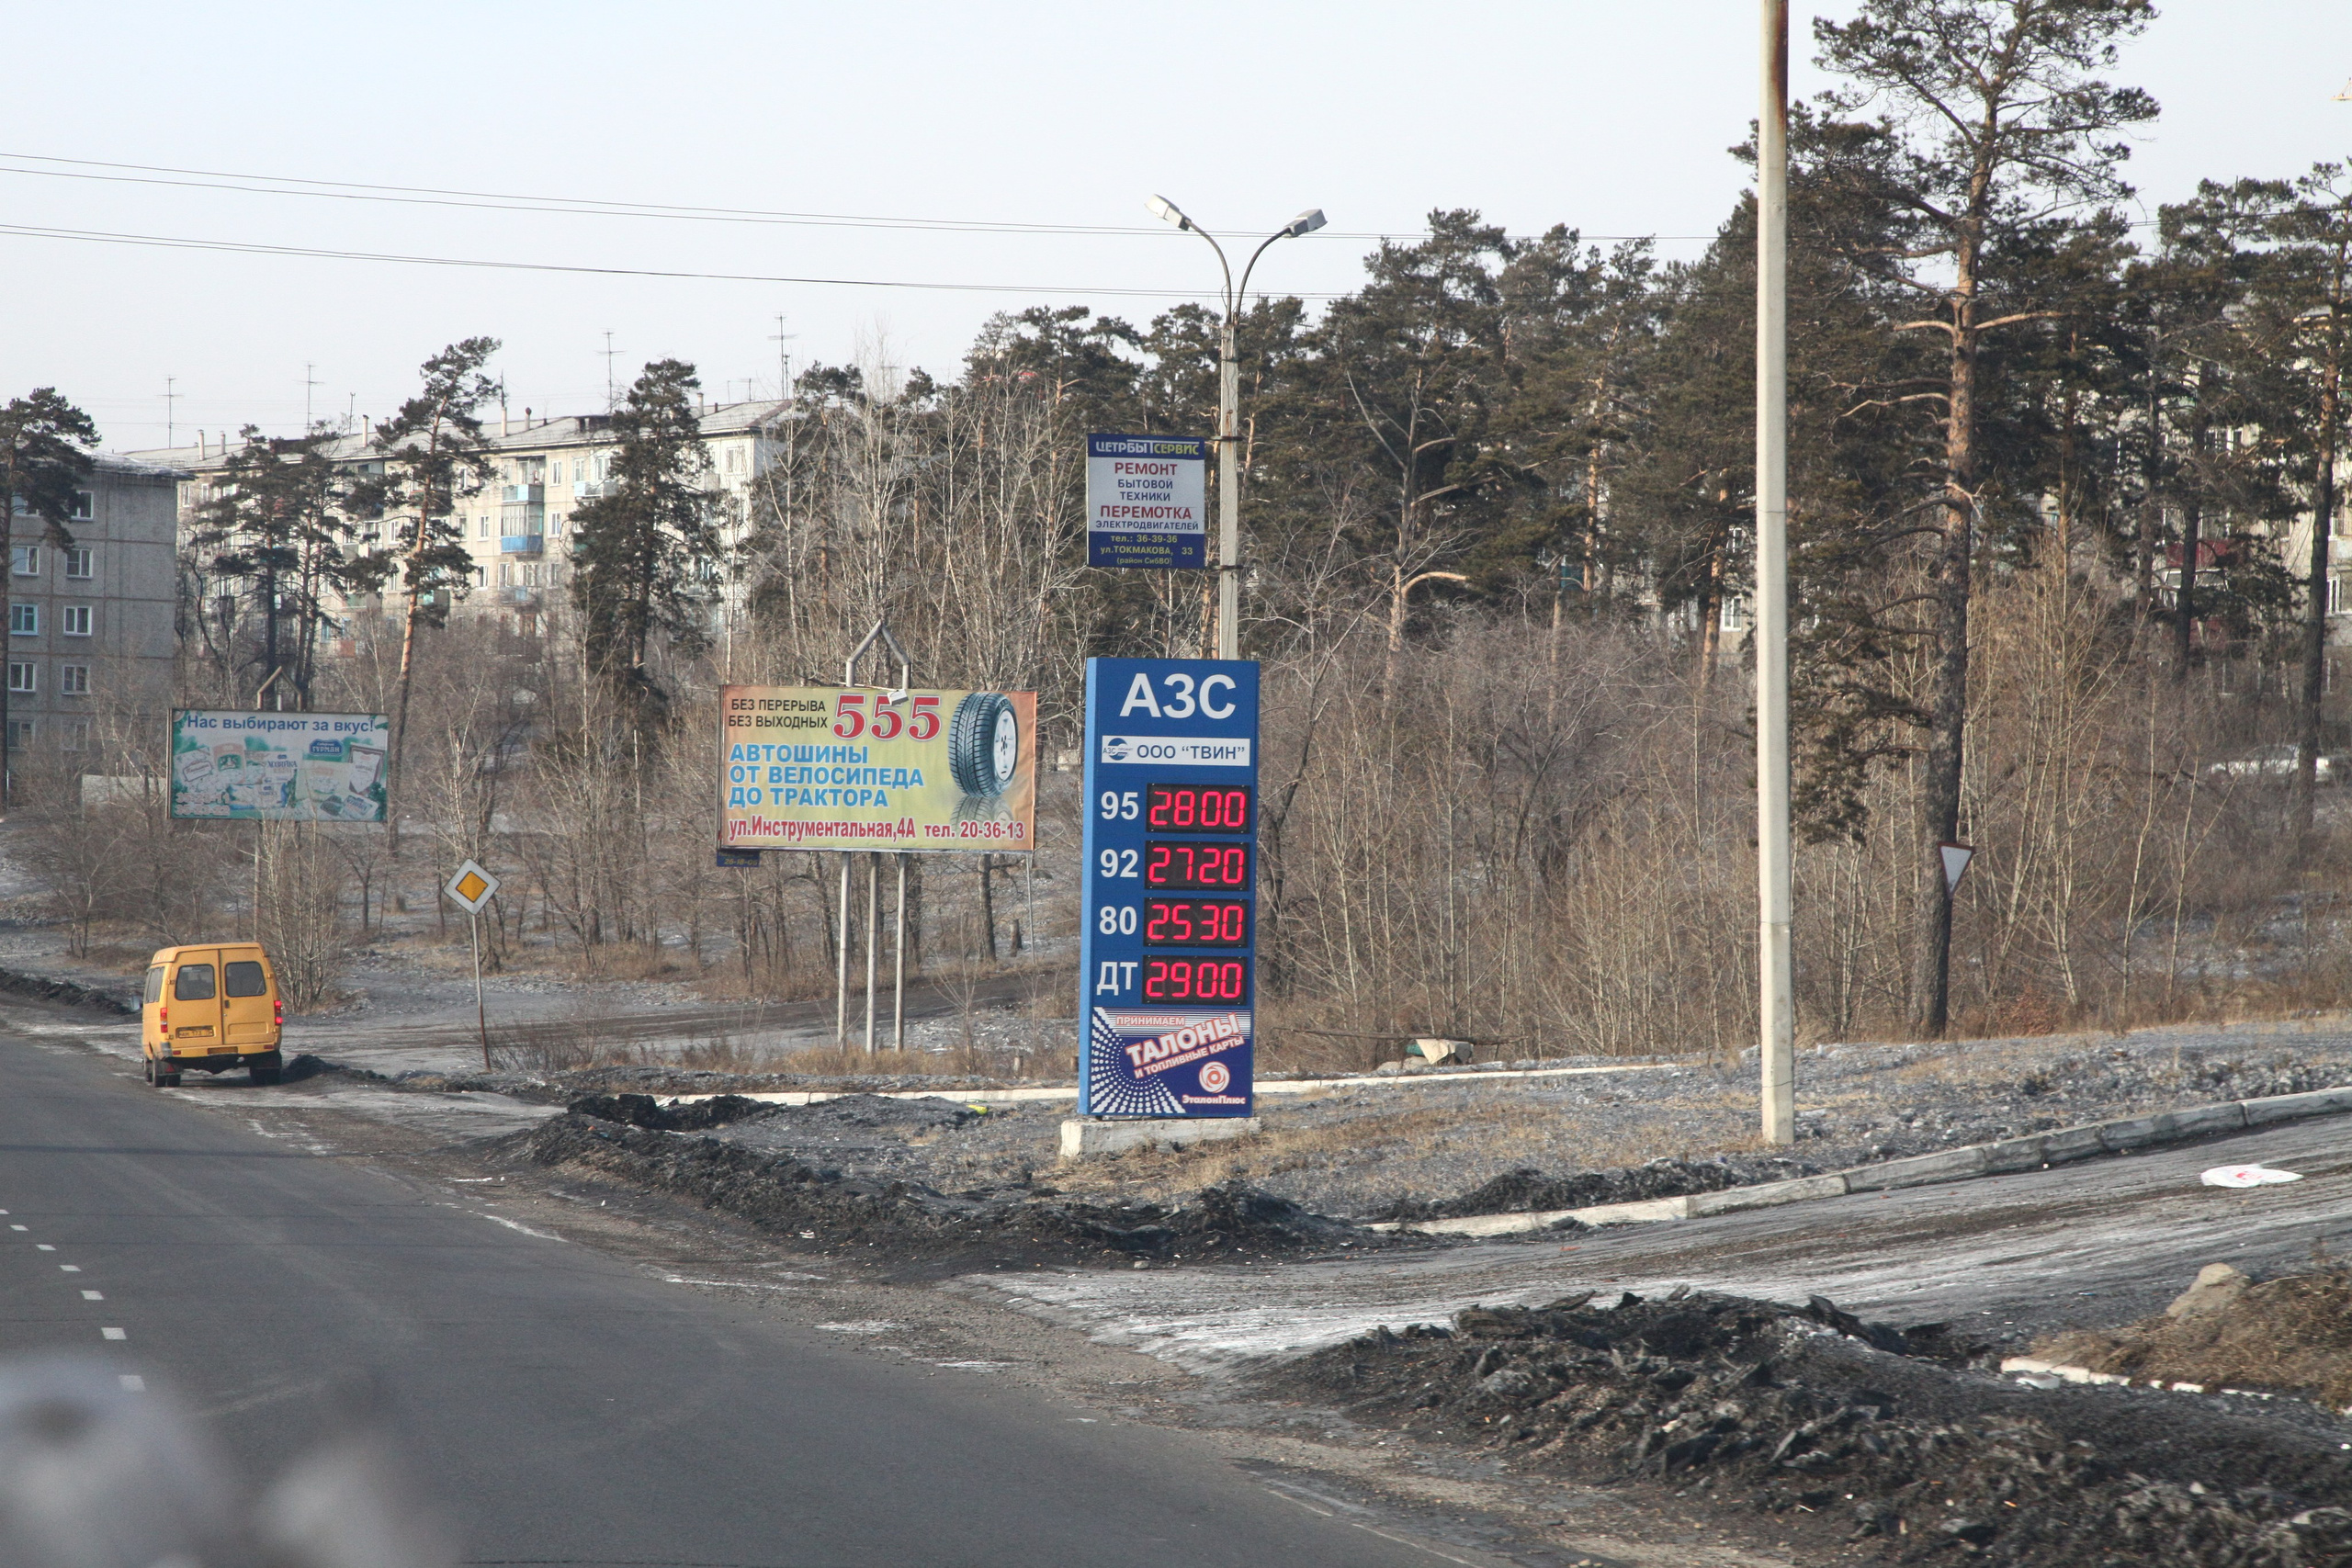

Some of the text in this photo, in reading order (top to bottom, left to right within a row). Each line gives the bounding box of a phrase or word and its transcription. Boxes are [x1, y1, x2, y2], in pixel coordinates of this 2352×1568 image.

[1114, 462, 1178, 475] РЕМОНТ
[1117, 479, 1173, 489] БЫТОВОЙ
[1120, 491, 1170, 502] ТЕХНИКИ
[1100, 505, 1192, 519] ПЕРЕМОТКА
[1095, 520, 1198, 530] ЭЛЕКТРОДВИГАТЕЛЕЙ
[1136, 535, 1178, 543] 36-39-36
[1182, 547, 1193, 555] 33
[1116, 557, 1143, 565] (район
[1119, 672, 1237, 719] АЗС
[731, 699, 826, 712] БЕЗ ПЕРЕРЫВА
[187, 716, 374, 734] Нас выбирают за вкус!
[729, 716, 828, 729] БЕЗ ВЫХОДНЫХ
[832, 694, 941, 741] 555
[729, 743, 868, 763] АВТОШИНЫ
[1136, 745, 1175, 758] ООО
[729, 766, 924, 790] ОТ ВЕЛОСИПЕДА
[729, 787, 888, 808] ДО ТРАКТОРА
[1101, 791, 1139, 820] 95
[924, 824, 956, 838] тел.
[960, 821, 1024, 840] 20-36-13
[1100, 849, 1138, 878] 92
[1099, 906, 1137, 935] 80
[1096, 961, 1138, 996] ДТ
[1115, 1015, 1185, 1027] ПРИНИМАЕМ
[1125, 1011, 1240, 1067] ТАЛОНЫ
[1134, 1036, 1245, 1079] И ТОПЛИВНЫЕ КАРТЫ
[1182, 1094, 1246, 1105] ЭталонПлюс
